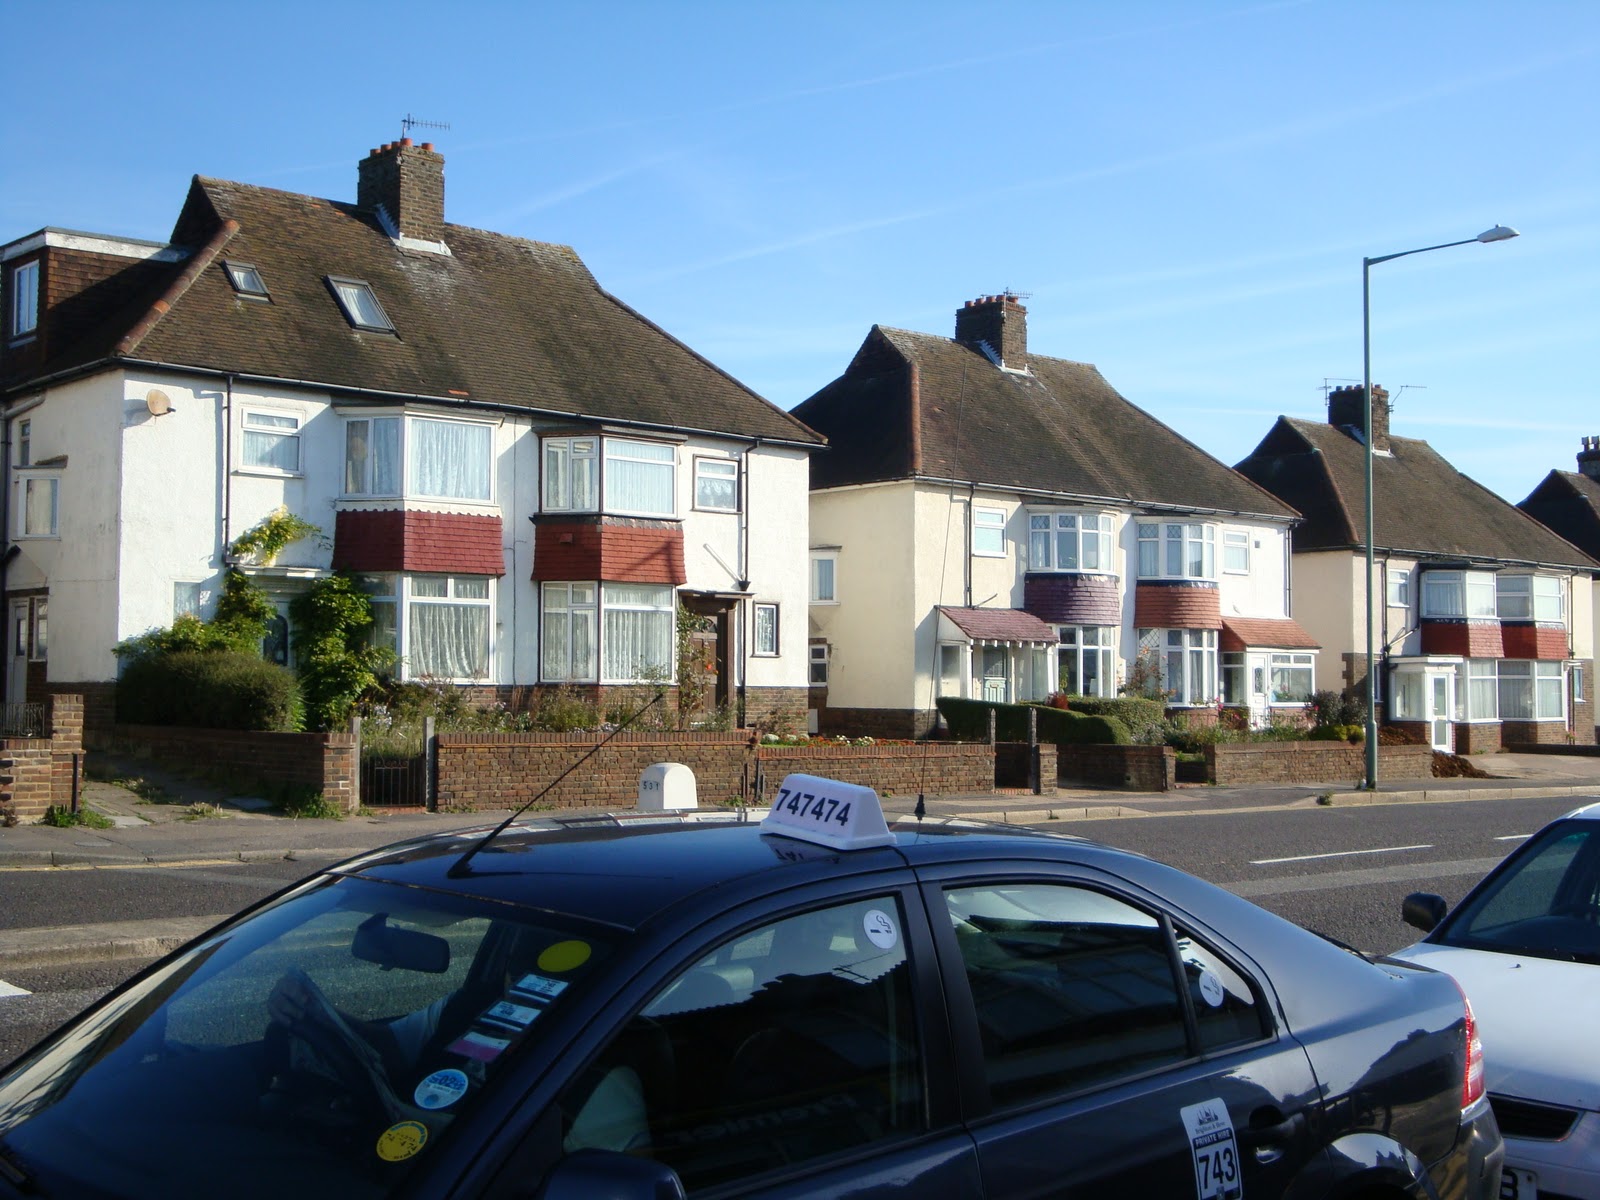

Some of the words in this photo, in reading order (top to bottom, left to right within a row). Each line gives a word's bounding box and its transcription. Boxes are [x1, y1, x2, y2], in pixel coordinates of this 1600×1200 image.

[776, 789, 851, 826] 747474
[1195, 1134, 1217, 1146] PRIVATE
[1217, 1129, 1230, 1140] HIRE
[1199, 1148, 1235, 1189] 743
